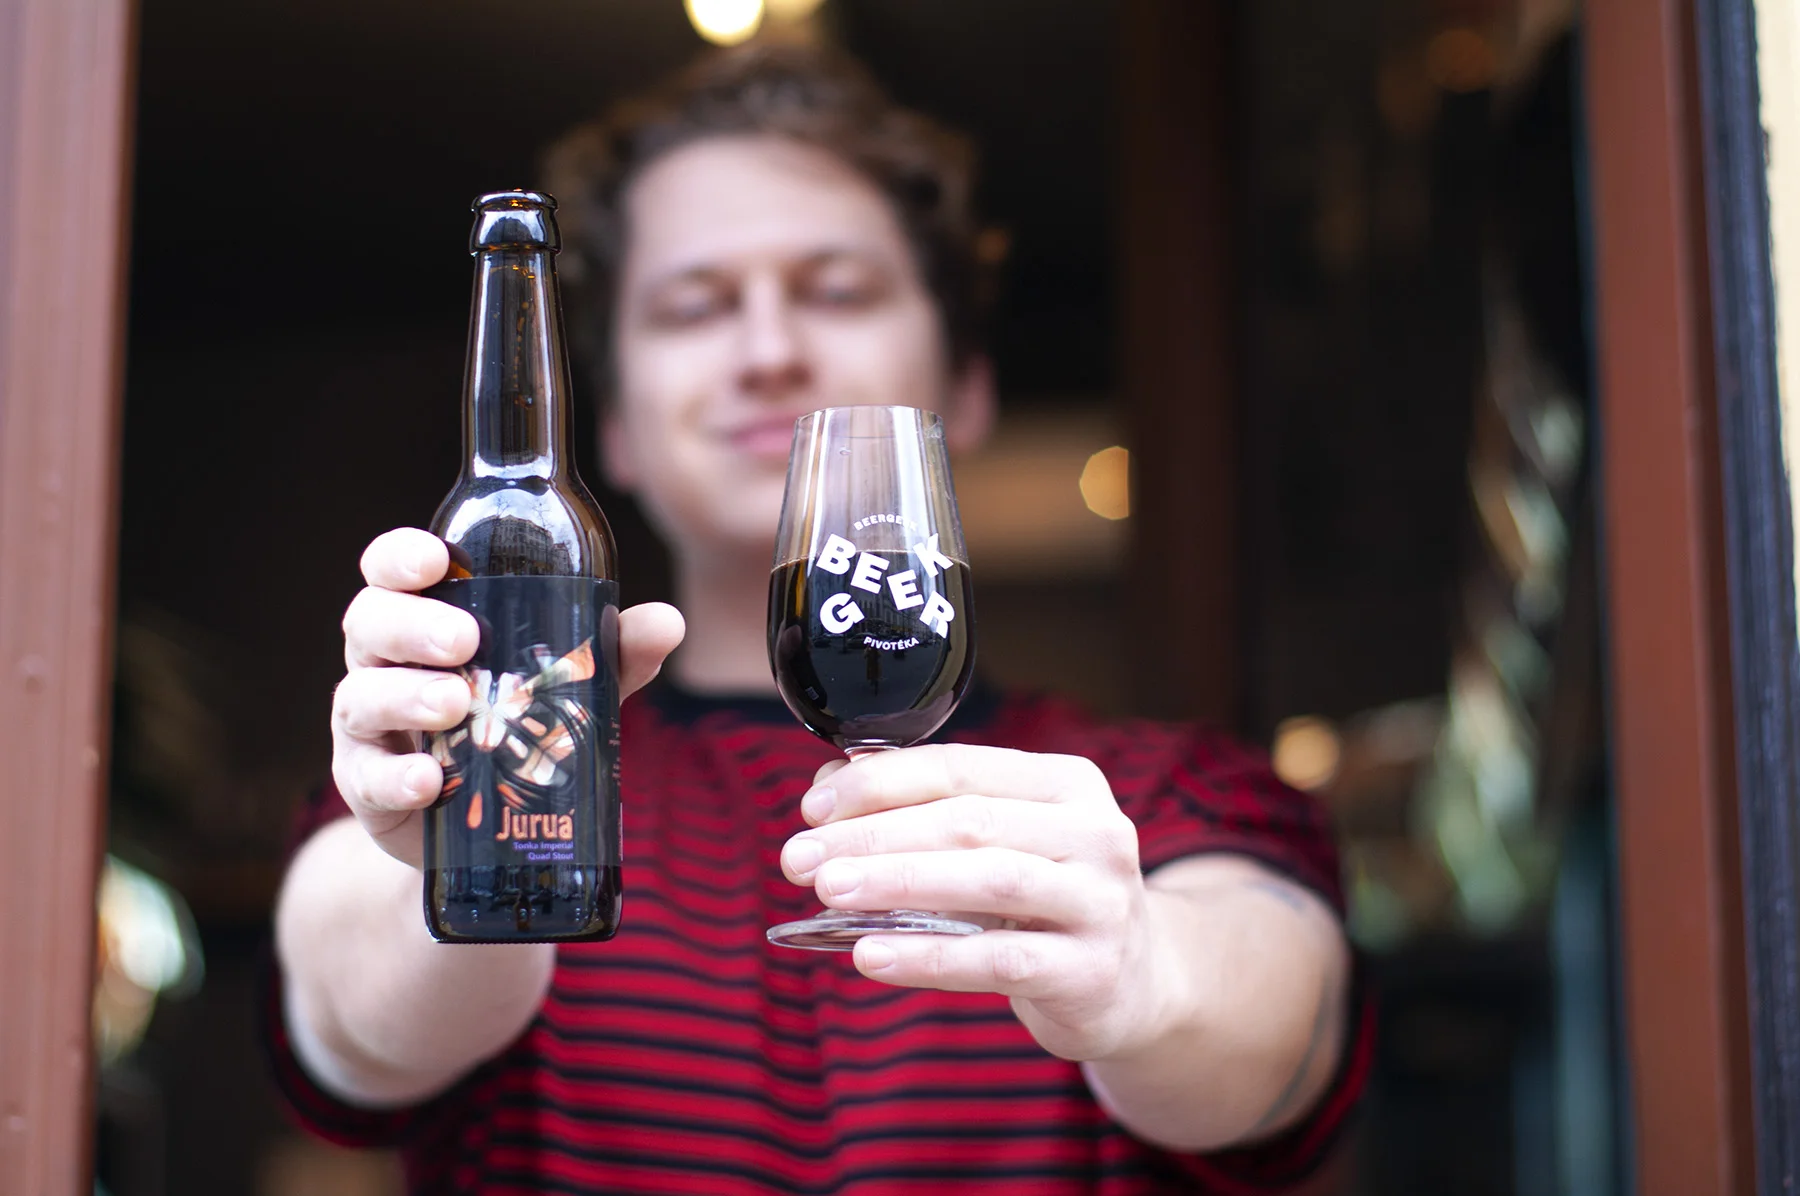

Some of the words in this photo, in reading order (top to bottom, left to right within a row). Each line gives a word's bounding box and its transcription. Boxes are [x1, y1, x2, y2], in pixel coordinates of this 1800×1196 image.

[853, 513, 918, 531] BEERGEK
[863, 636, 919, 650] PIVOTÉKA
[496, 805, 575, 841] Juruá
[513, 841, 539, 850] Tonka
[541, 841, 574, 851] Imperial
[528, 851, 550, 860] Quad
[552, 851, 574, 860] Stout
